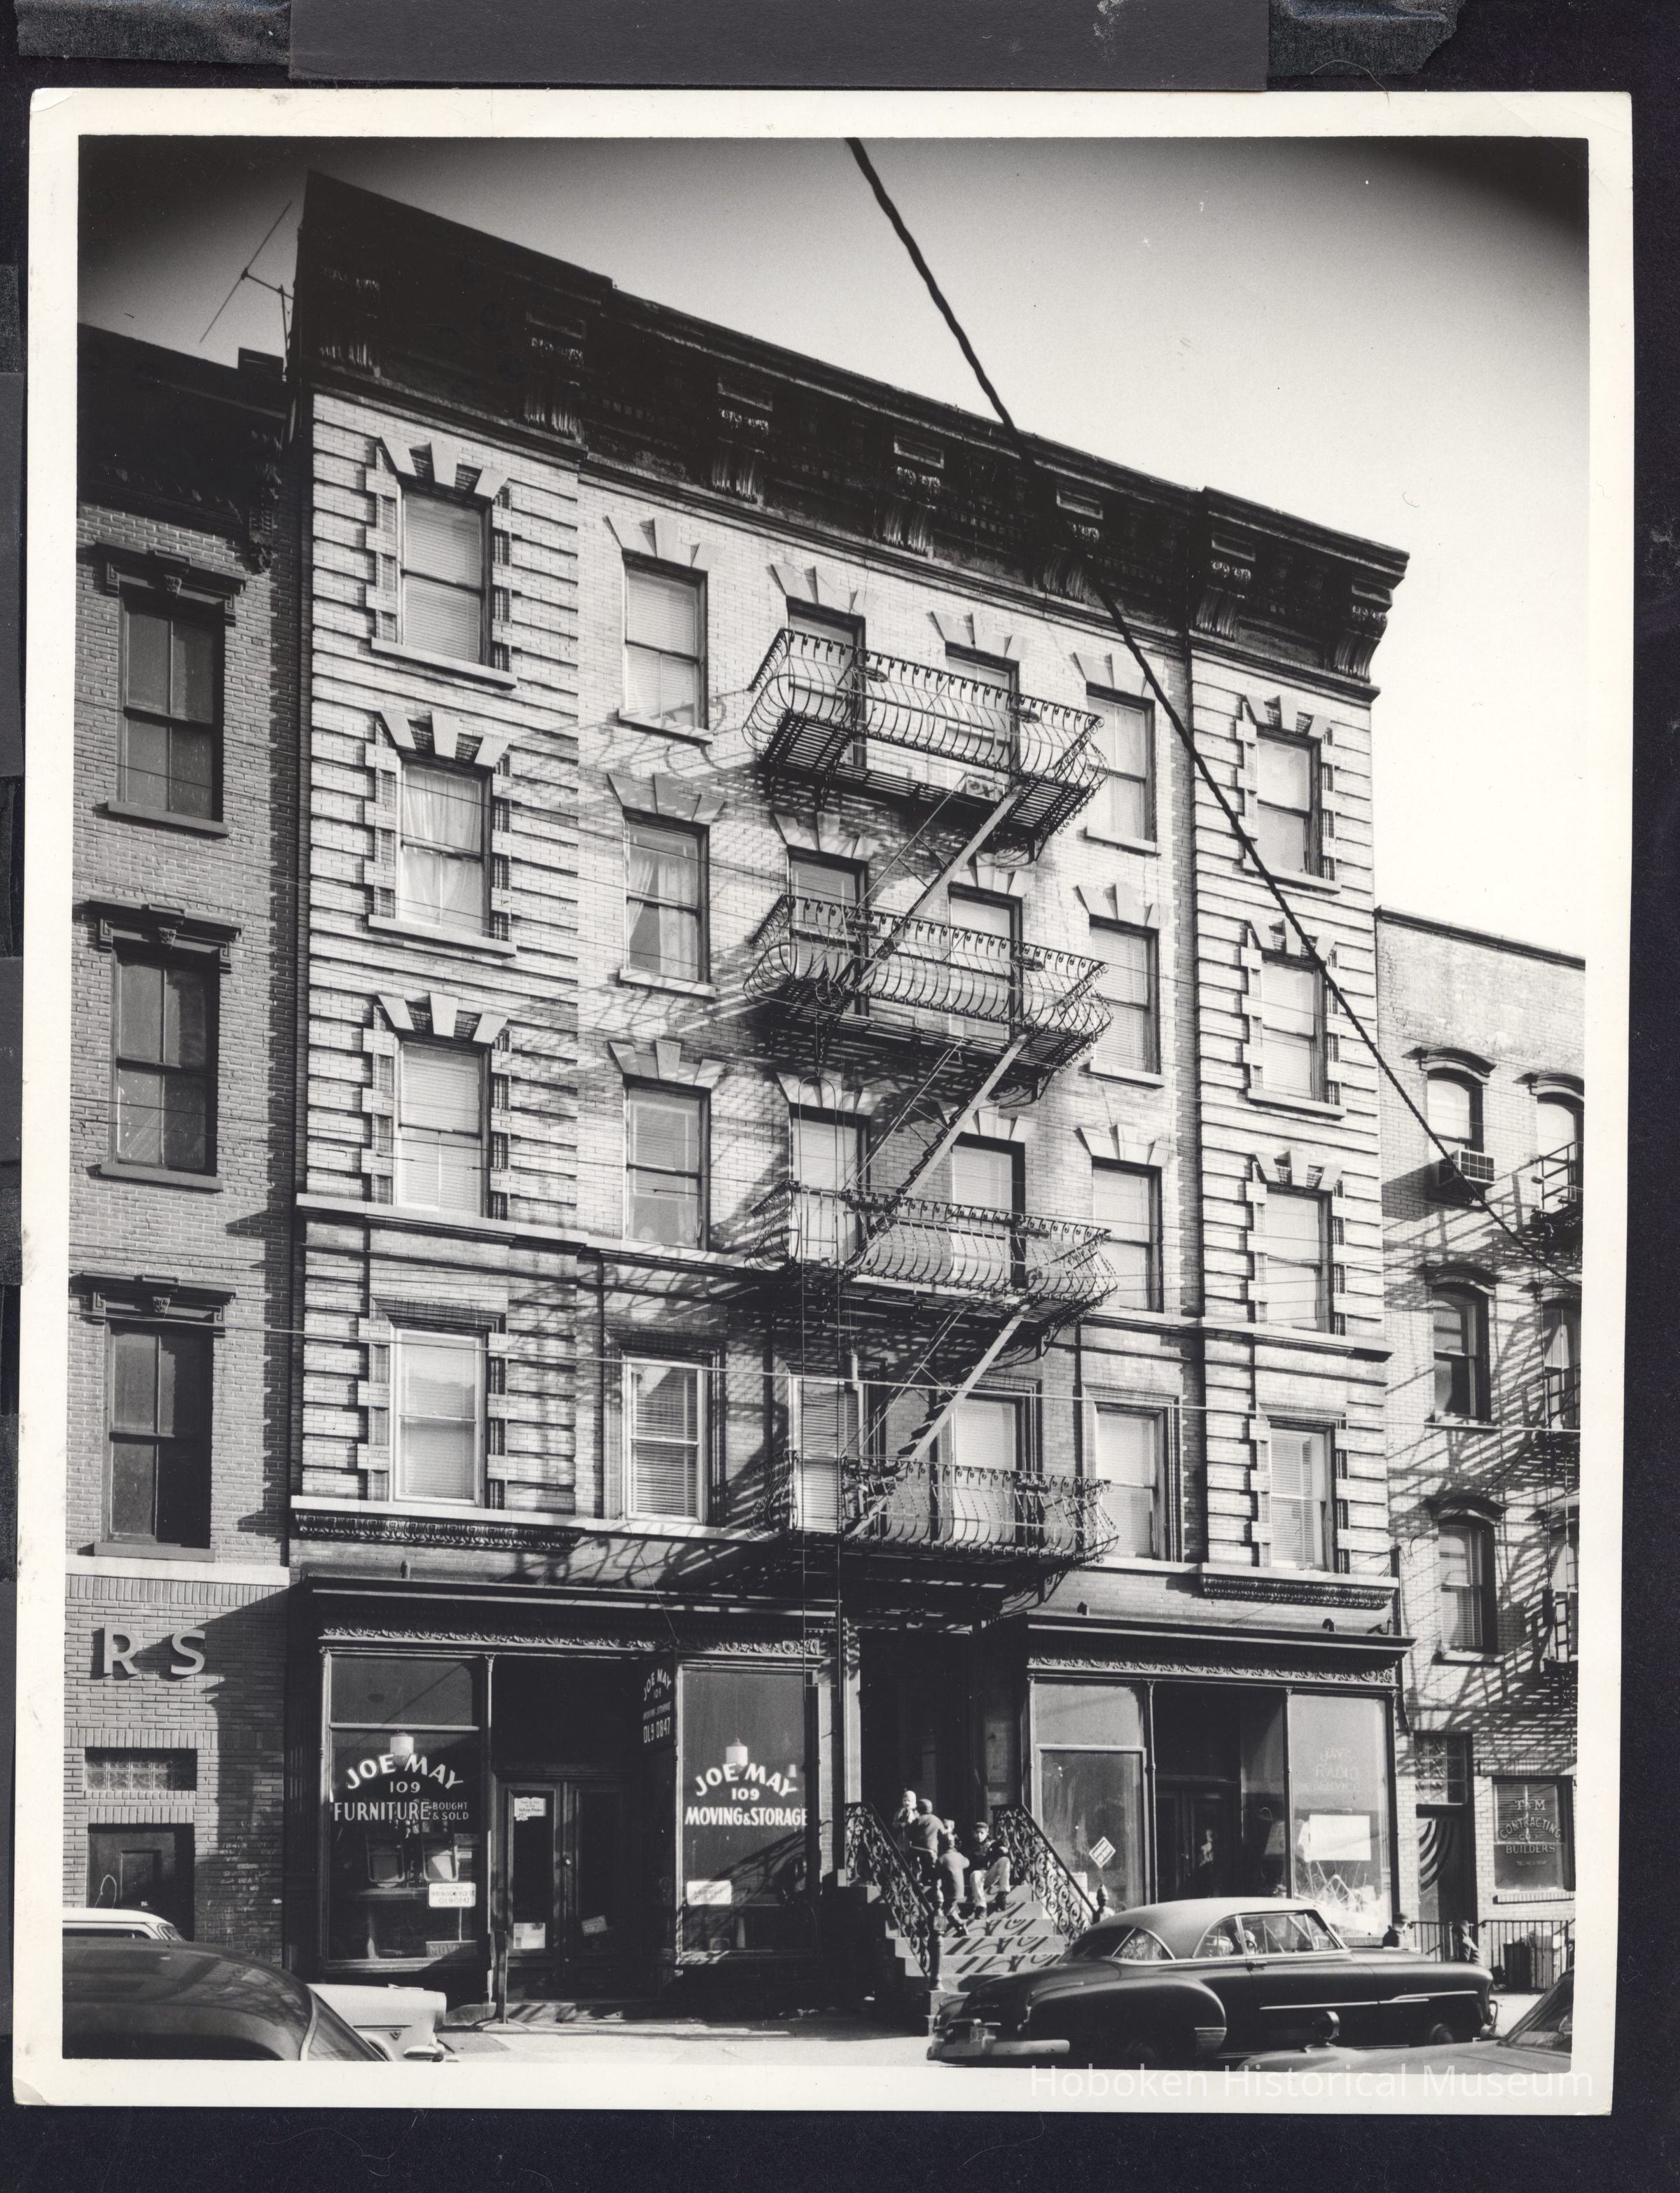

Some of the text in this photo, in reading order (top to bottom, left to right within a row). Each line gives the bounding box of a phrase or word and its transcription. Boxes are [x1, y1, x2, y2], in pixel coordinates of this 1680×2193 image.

[644, 1669, 672, 1701] JOE MAY
[653, 1687, 662, 1699] 109
[347, 1753, 464, 1790] JOE MAY
[695, 1762, 798, 1797] JOE MAY
[389, 1781, 421, 1793] 109
[731, 1788, 761, 1801] 109
[334, 1802, 431, 1821] FURNITURE
[432, 1802, 468, 1810] BOUGHT
[432, 1811, 469, 1820] & SOLD
[1500, 1816, 1561, 1839] CONTRACTING
[1506, 1844, 1555, 1854] BUILDERS
